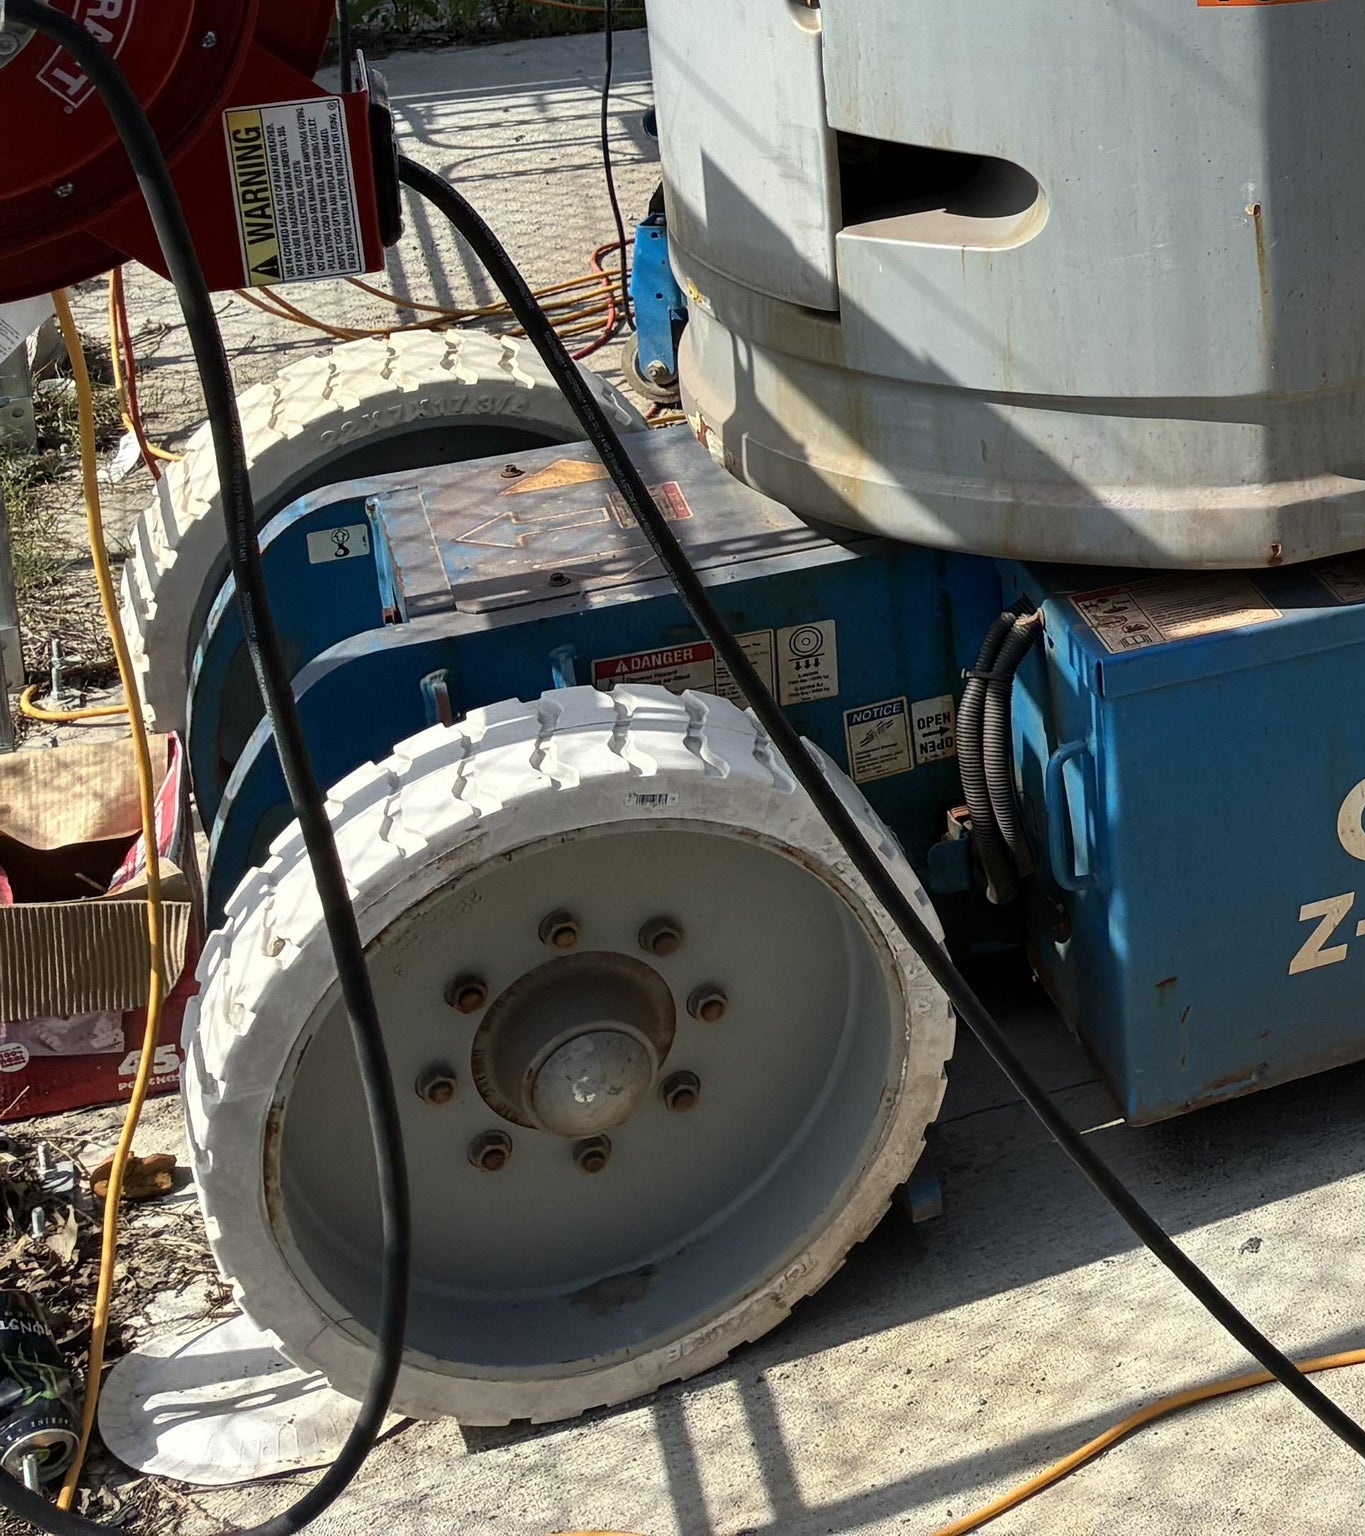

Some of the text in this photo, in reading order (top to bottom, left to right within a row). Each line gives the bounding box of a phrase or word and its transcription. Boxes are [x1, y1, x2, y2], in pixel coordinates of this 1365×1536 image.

[231, 125, 275, 245] WARNING
[631, 649, 693, 670] DANGER
[852, 703, 901, 724] NOTICE
[917, 712, 951, 731] OPEN
[919, 736, 953, 755] OPEN
[118, 1044, 182, 1076] 45
